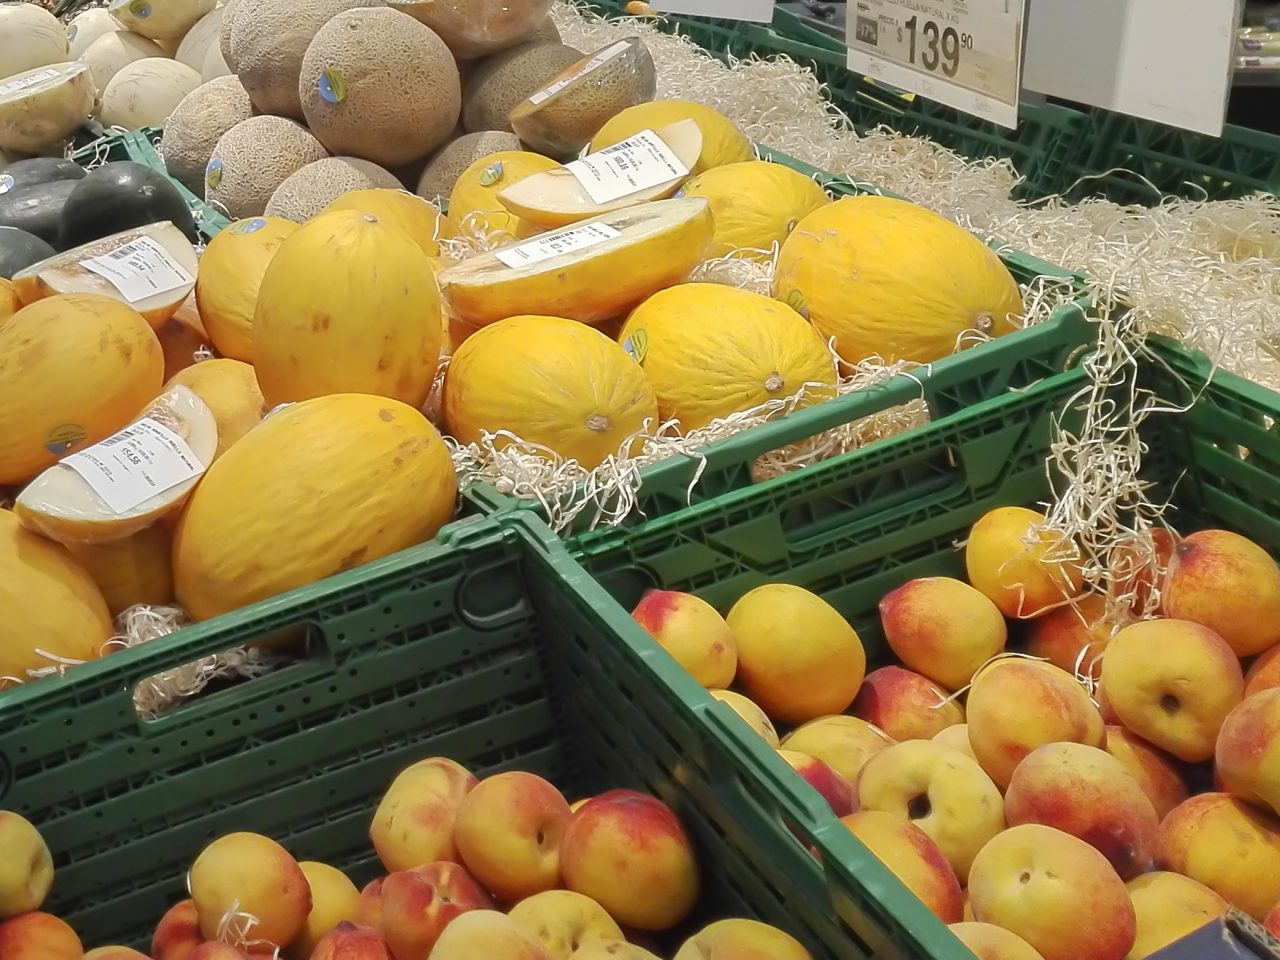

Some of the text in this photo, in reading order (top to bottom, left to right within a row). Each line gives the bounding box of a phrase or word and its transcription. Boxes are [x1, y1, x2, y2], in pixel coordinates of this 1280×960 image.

[897, 15, 974, 79] $ 139 90
